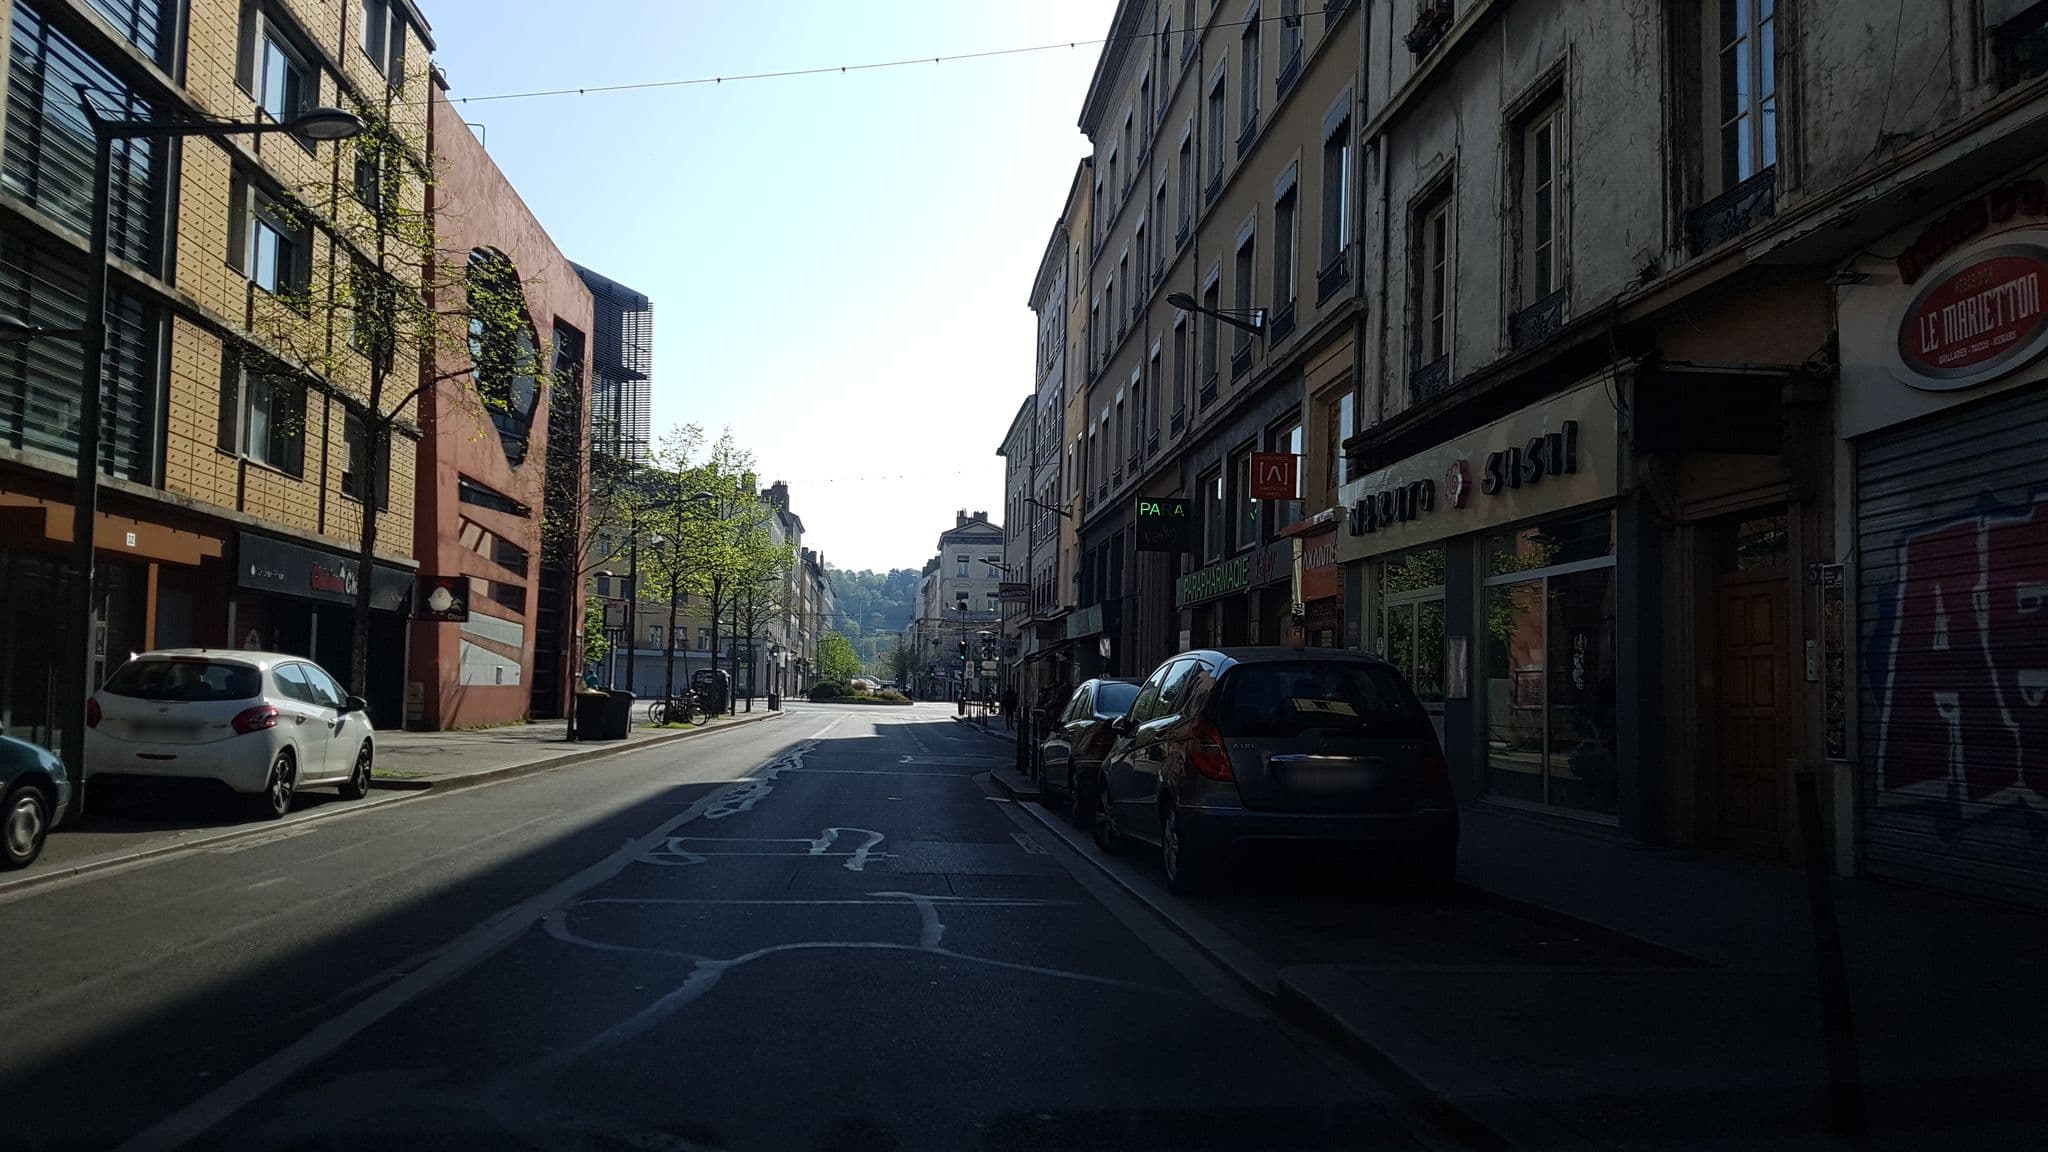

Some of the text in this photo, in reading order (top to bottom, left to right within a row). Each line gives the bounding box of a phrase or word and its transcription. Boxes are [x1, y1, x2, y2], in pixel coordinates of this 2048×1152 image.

[1920, 311, 1940, 354] LE
[1942, 271, 2040, 345] MARIETTON
[1350, 420, 1578, 537] NARUTO SUSHI
[1183, 553, 1250, 603] PARAPHARMACIE
